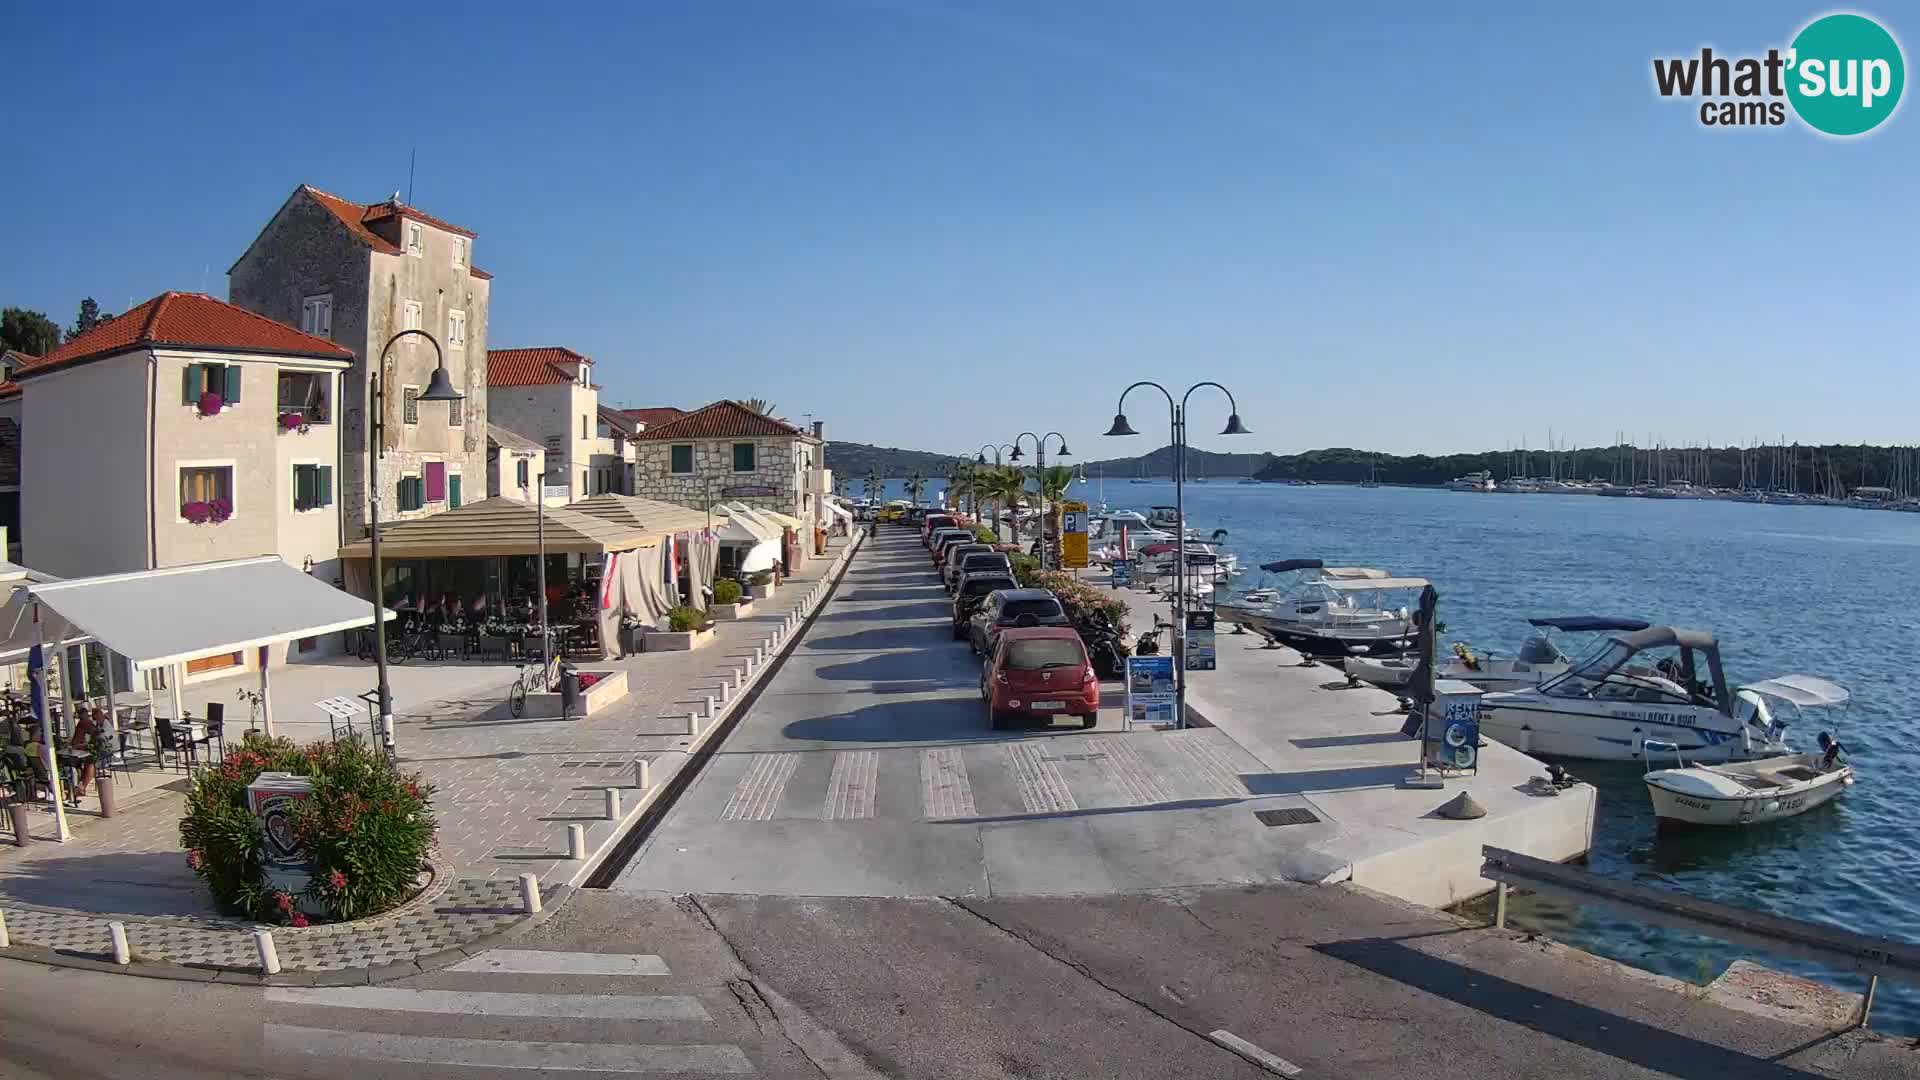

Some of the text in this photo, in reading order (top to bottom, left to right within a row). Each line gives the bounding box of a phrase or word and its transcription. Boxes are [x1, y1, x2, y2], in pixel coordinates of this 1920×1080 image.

[1064, 514, 1075, 530] P
[1447, 703, 1478, 712] RENT
[1446, 712, 1453, 720] A
